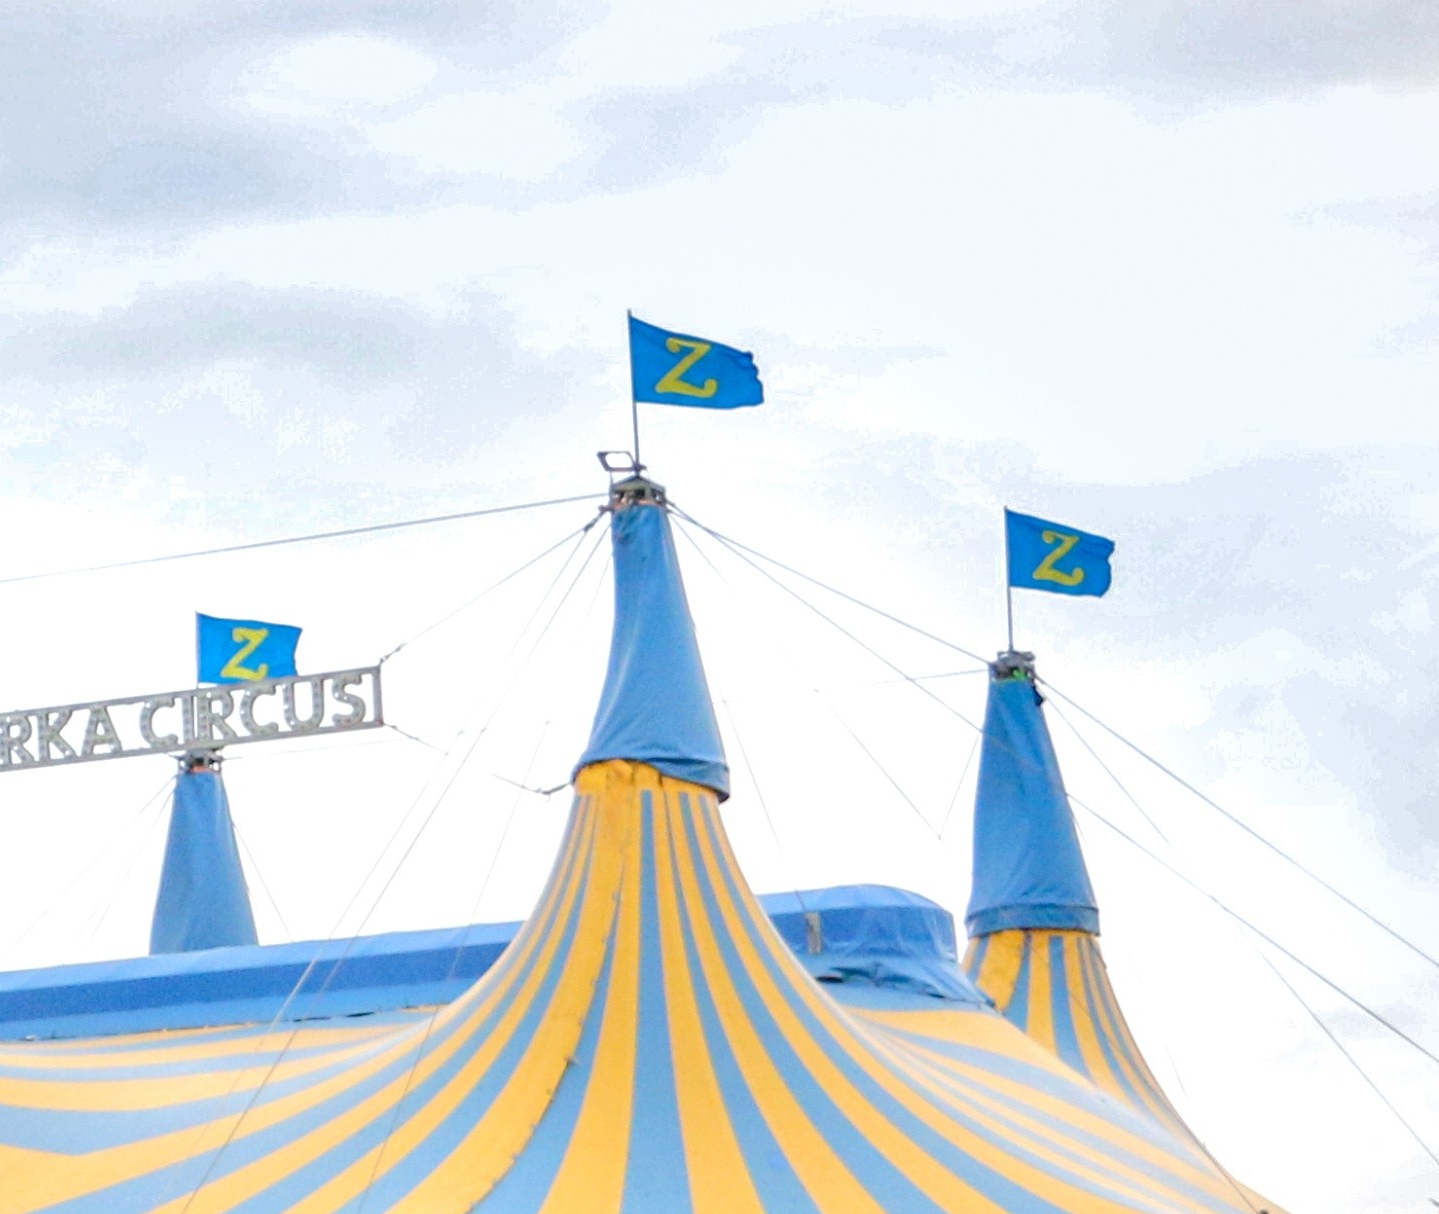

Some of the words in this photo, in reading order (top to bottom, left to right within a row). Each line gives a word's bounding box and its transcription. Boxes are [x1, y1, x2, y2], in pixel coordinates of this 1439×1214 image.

[654, 336, 718, 398] Z
[1032, 529, 1084, 586] Z
[220, 627, 269, 682] Z
[139, 673, 367, 750] CIRCUS
